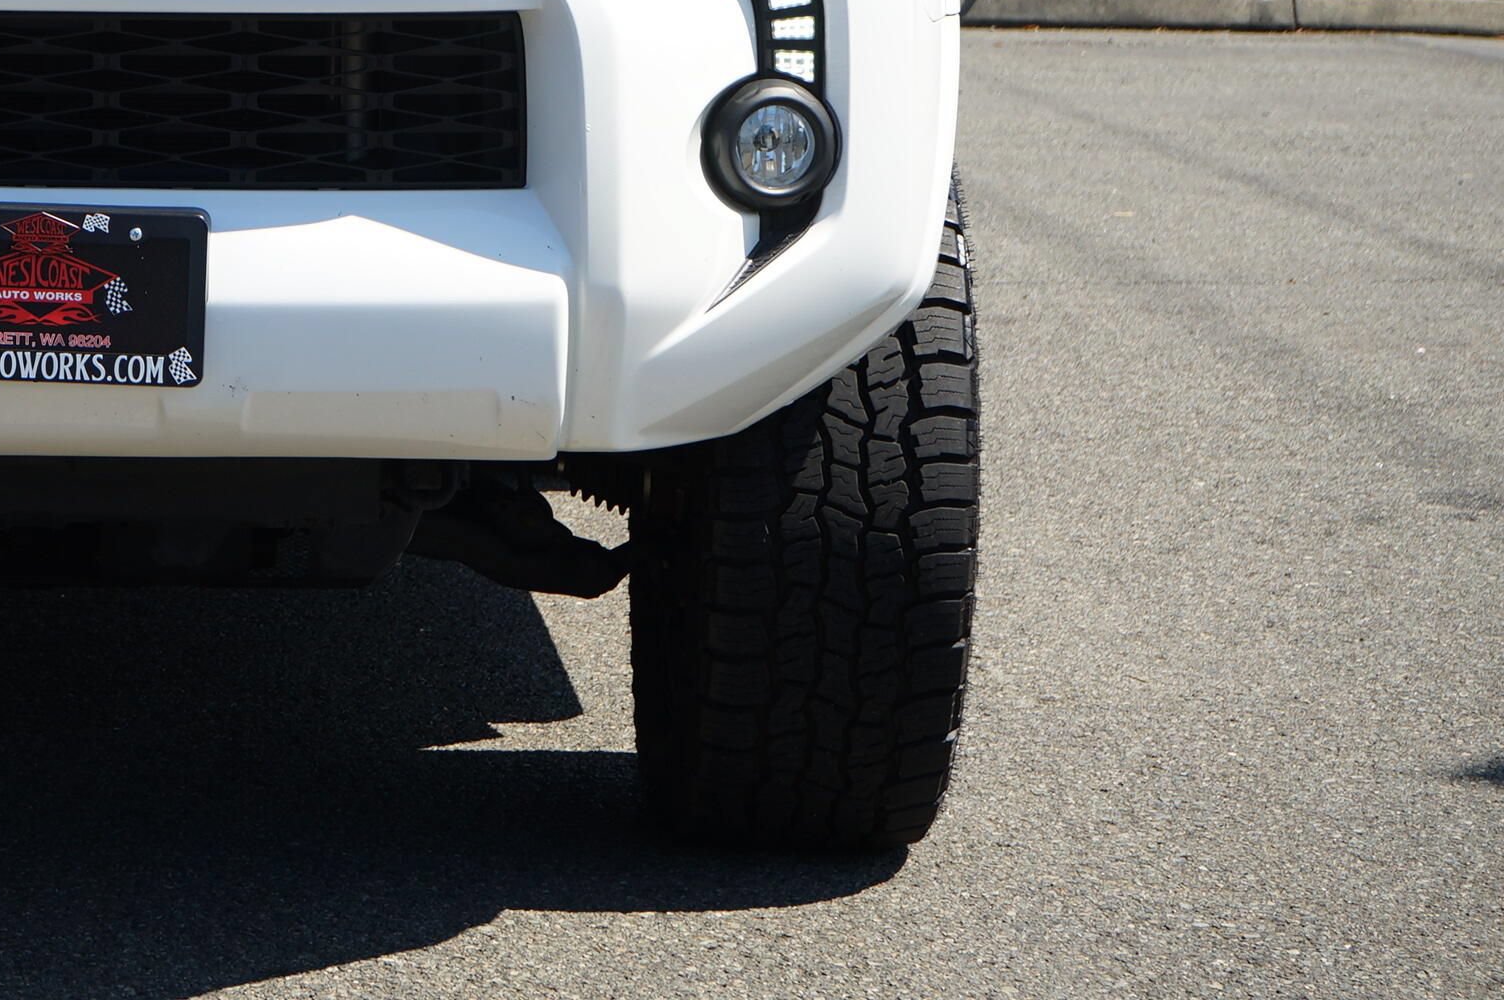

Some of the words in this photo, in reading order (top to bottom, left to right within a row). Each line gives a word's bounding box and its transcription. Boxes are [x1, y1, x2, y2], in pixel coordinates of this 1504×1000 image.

[33, 291, 82, 301] WORKS
[40, 333, 65, 346] WA
[68, 334, 111, 348] 98204
